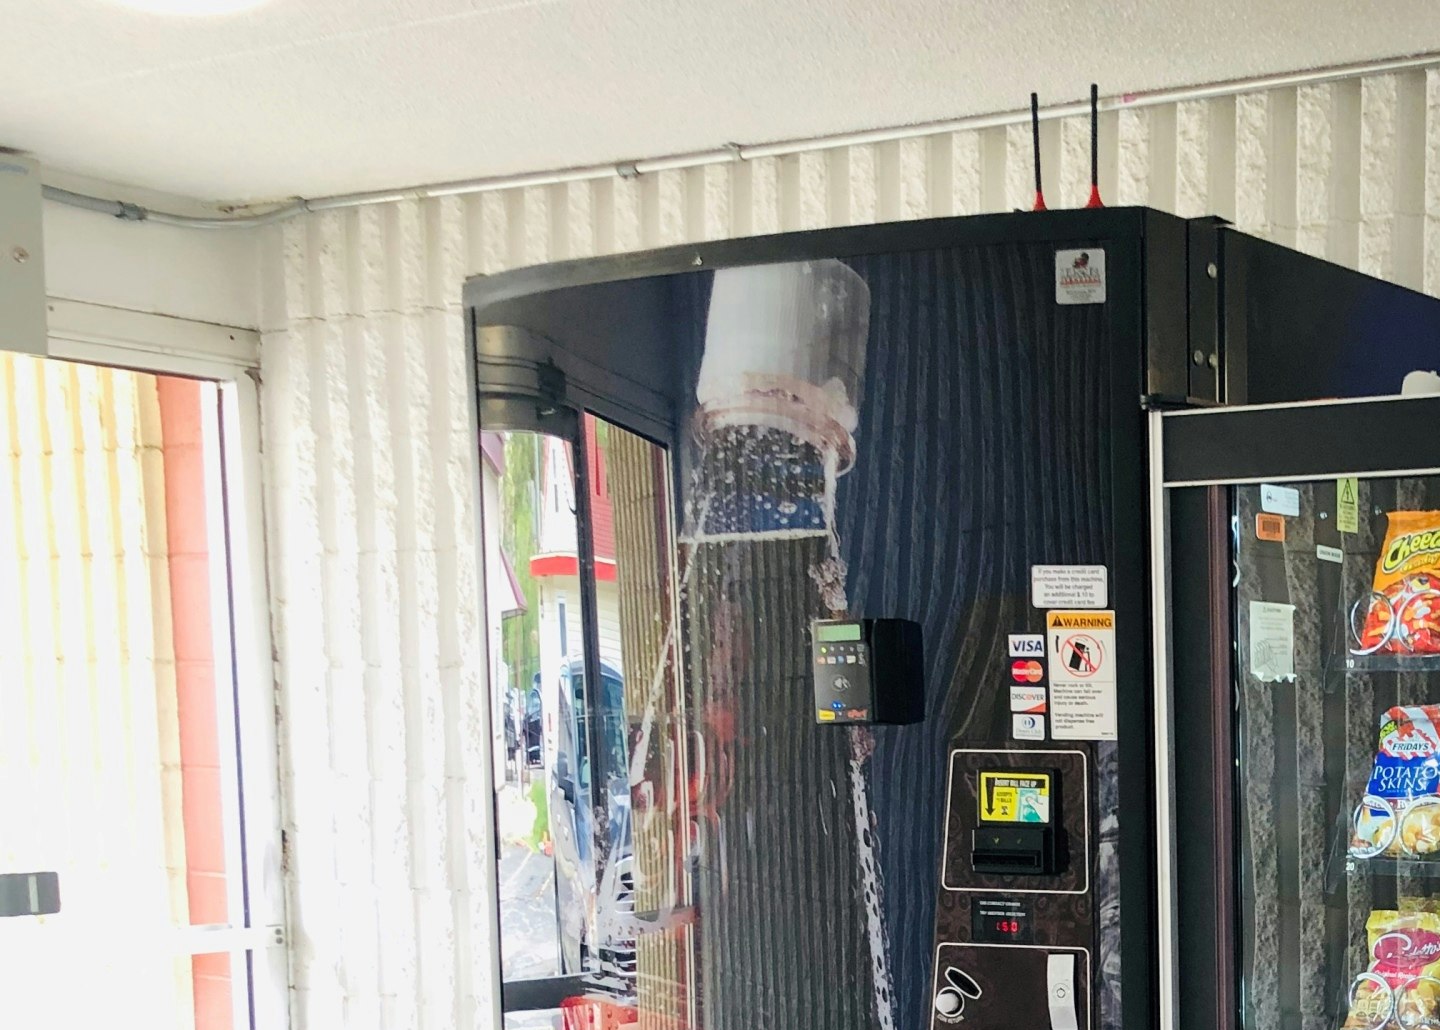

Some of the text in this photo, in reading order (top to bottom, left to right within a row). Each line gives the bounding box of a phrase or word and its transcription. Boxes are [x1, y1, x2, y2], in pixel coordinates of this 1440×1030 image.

[1063, 618, 1112, 627] WARNING
[1012, 640, 1043, 652] VISA
[1346, 659, 1355, 668] 10
[1391, 742, 1429, 751] FRIDAYS
[1373, 765, 1438, 781] POTATO
[1378, 777, 1424, 792] SKINS
[1346, 862, 1355, 871] 20
